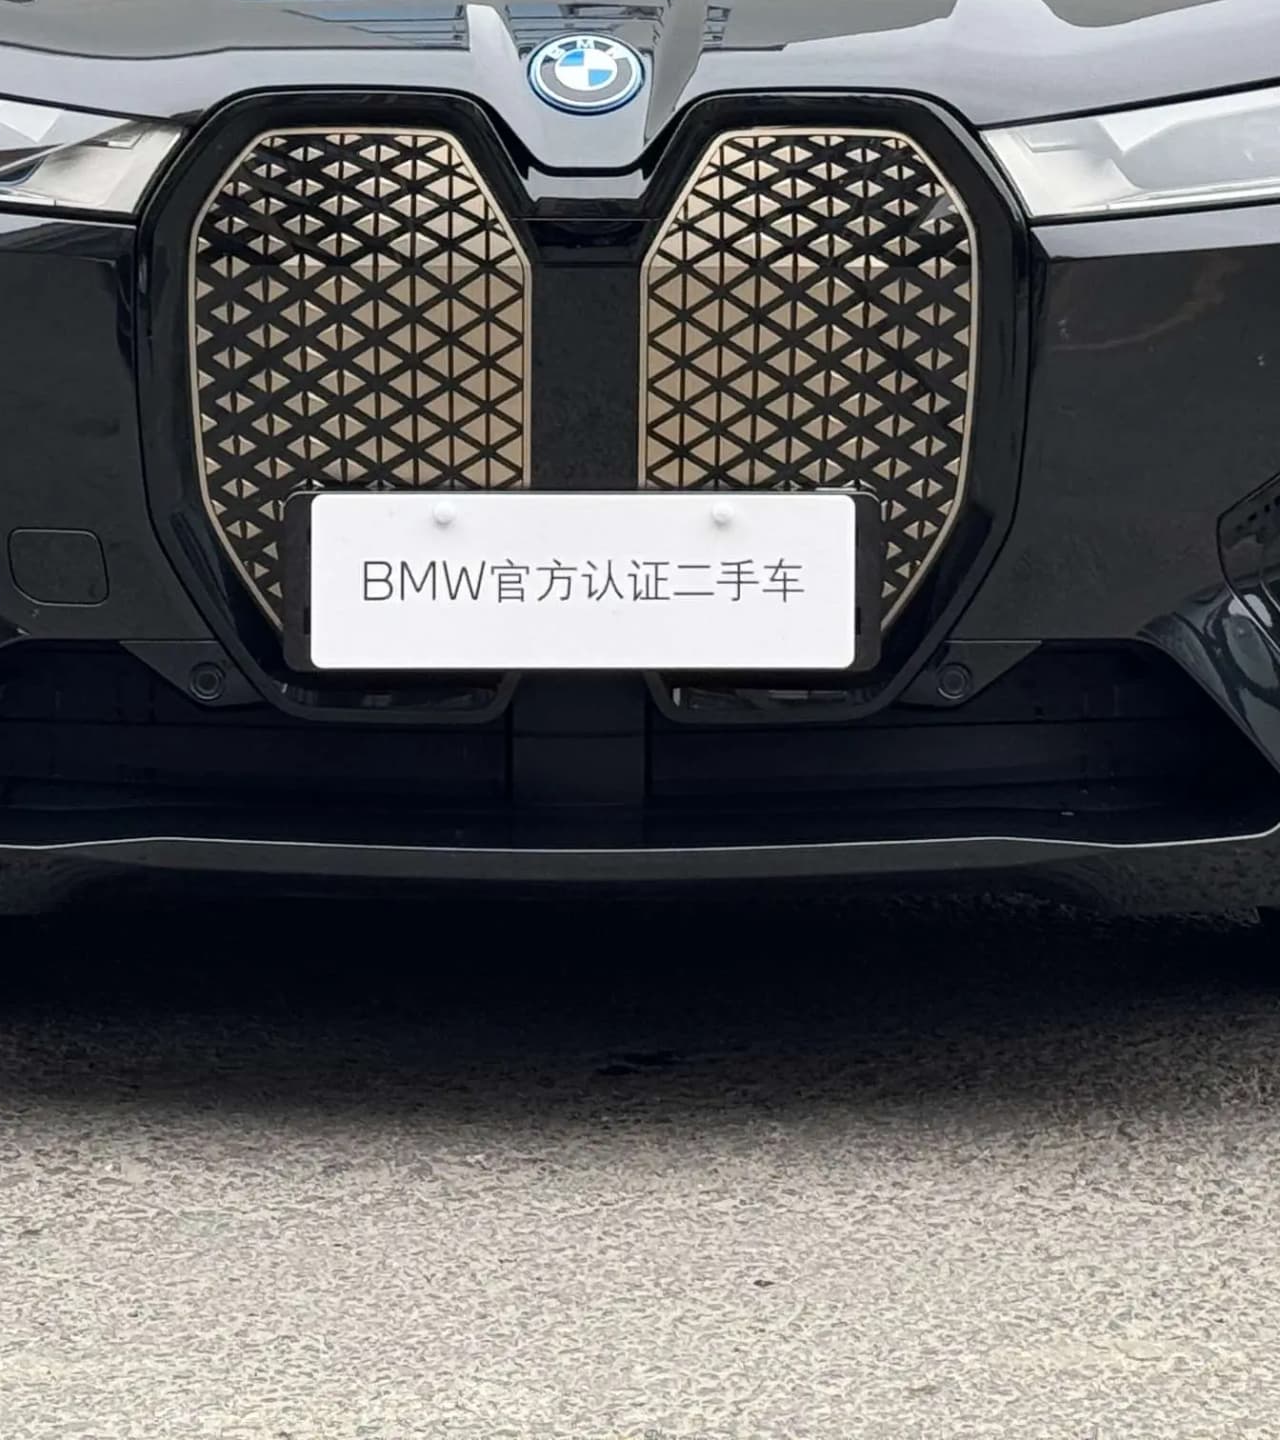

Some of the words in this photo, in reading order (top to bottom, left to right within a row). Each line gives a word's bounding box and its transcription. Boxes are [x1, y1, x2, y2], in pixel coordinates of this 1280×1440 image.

[362, 557, 806, 604] BMW官方认证二手车
